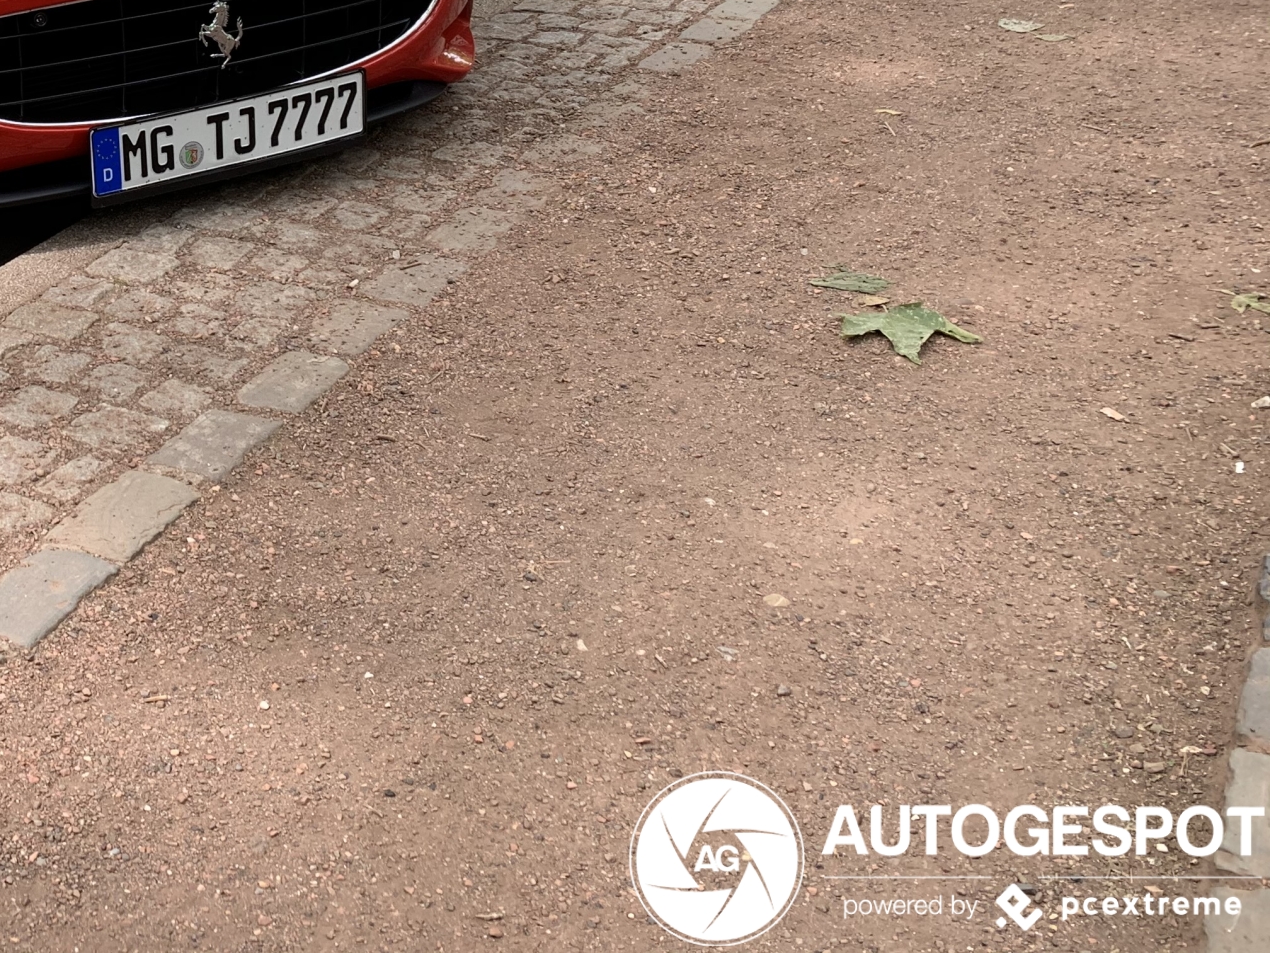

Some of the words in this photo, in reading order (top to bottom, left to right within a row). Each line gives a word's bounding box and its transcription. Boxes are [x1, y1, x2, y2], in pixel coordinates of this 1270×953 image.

[103, 168, 113, 182] D
[122, 125, 175, 182] MG
[207, 106, 255, 161] TJ
[268, 81, 357, 147] 7777
